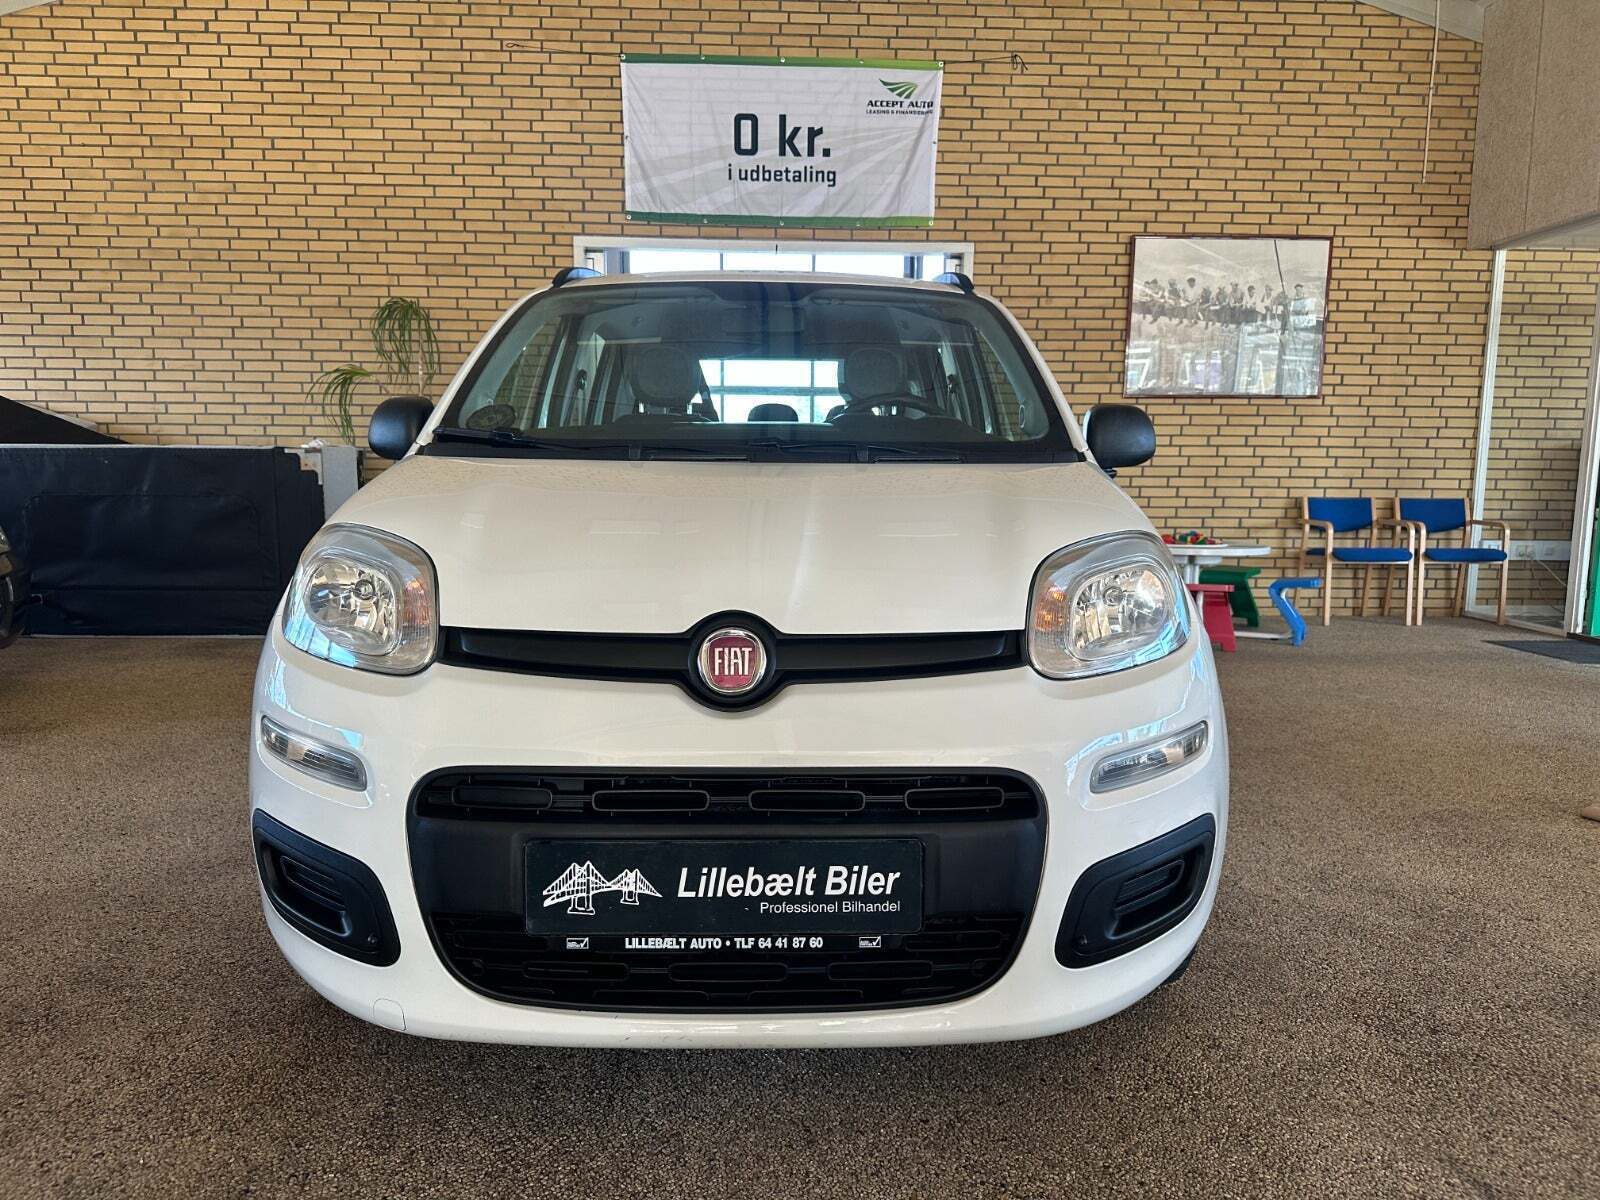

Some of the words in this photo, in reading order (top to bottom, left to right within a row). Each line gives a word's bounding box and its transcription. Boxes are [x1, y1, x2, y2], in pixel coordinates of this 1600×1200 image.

[867, 99, 905, 108] ACCEPT
[907, 100, 934, 109] AUTO
[778, 114, 831, 157] kr.
[728, 163, 732, 181] i
[738, 165, 837, 187] udbetaling
[714, 647, 752, 676] FIAT
[677, 866, 818, 899] Lillebælt
[823, 865, 901, 897] Biler
[760, 901, 839, 914] Professionel
[842, 900, 901, 913] Bilhandel
[625, 937, 687, 950] LILLEBÆLT
[690, 937, 722, 950] AUTO
[734, 937, 755, 950] TLF
[758, 937, 772, 950] 64
[775, 937, 788, 950] 41
[792, 937, 806, 949] 87
[809, 937, 824, 949] 60
